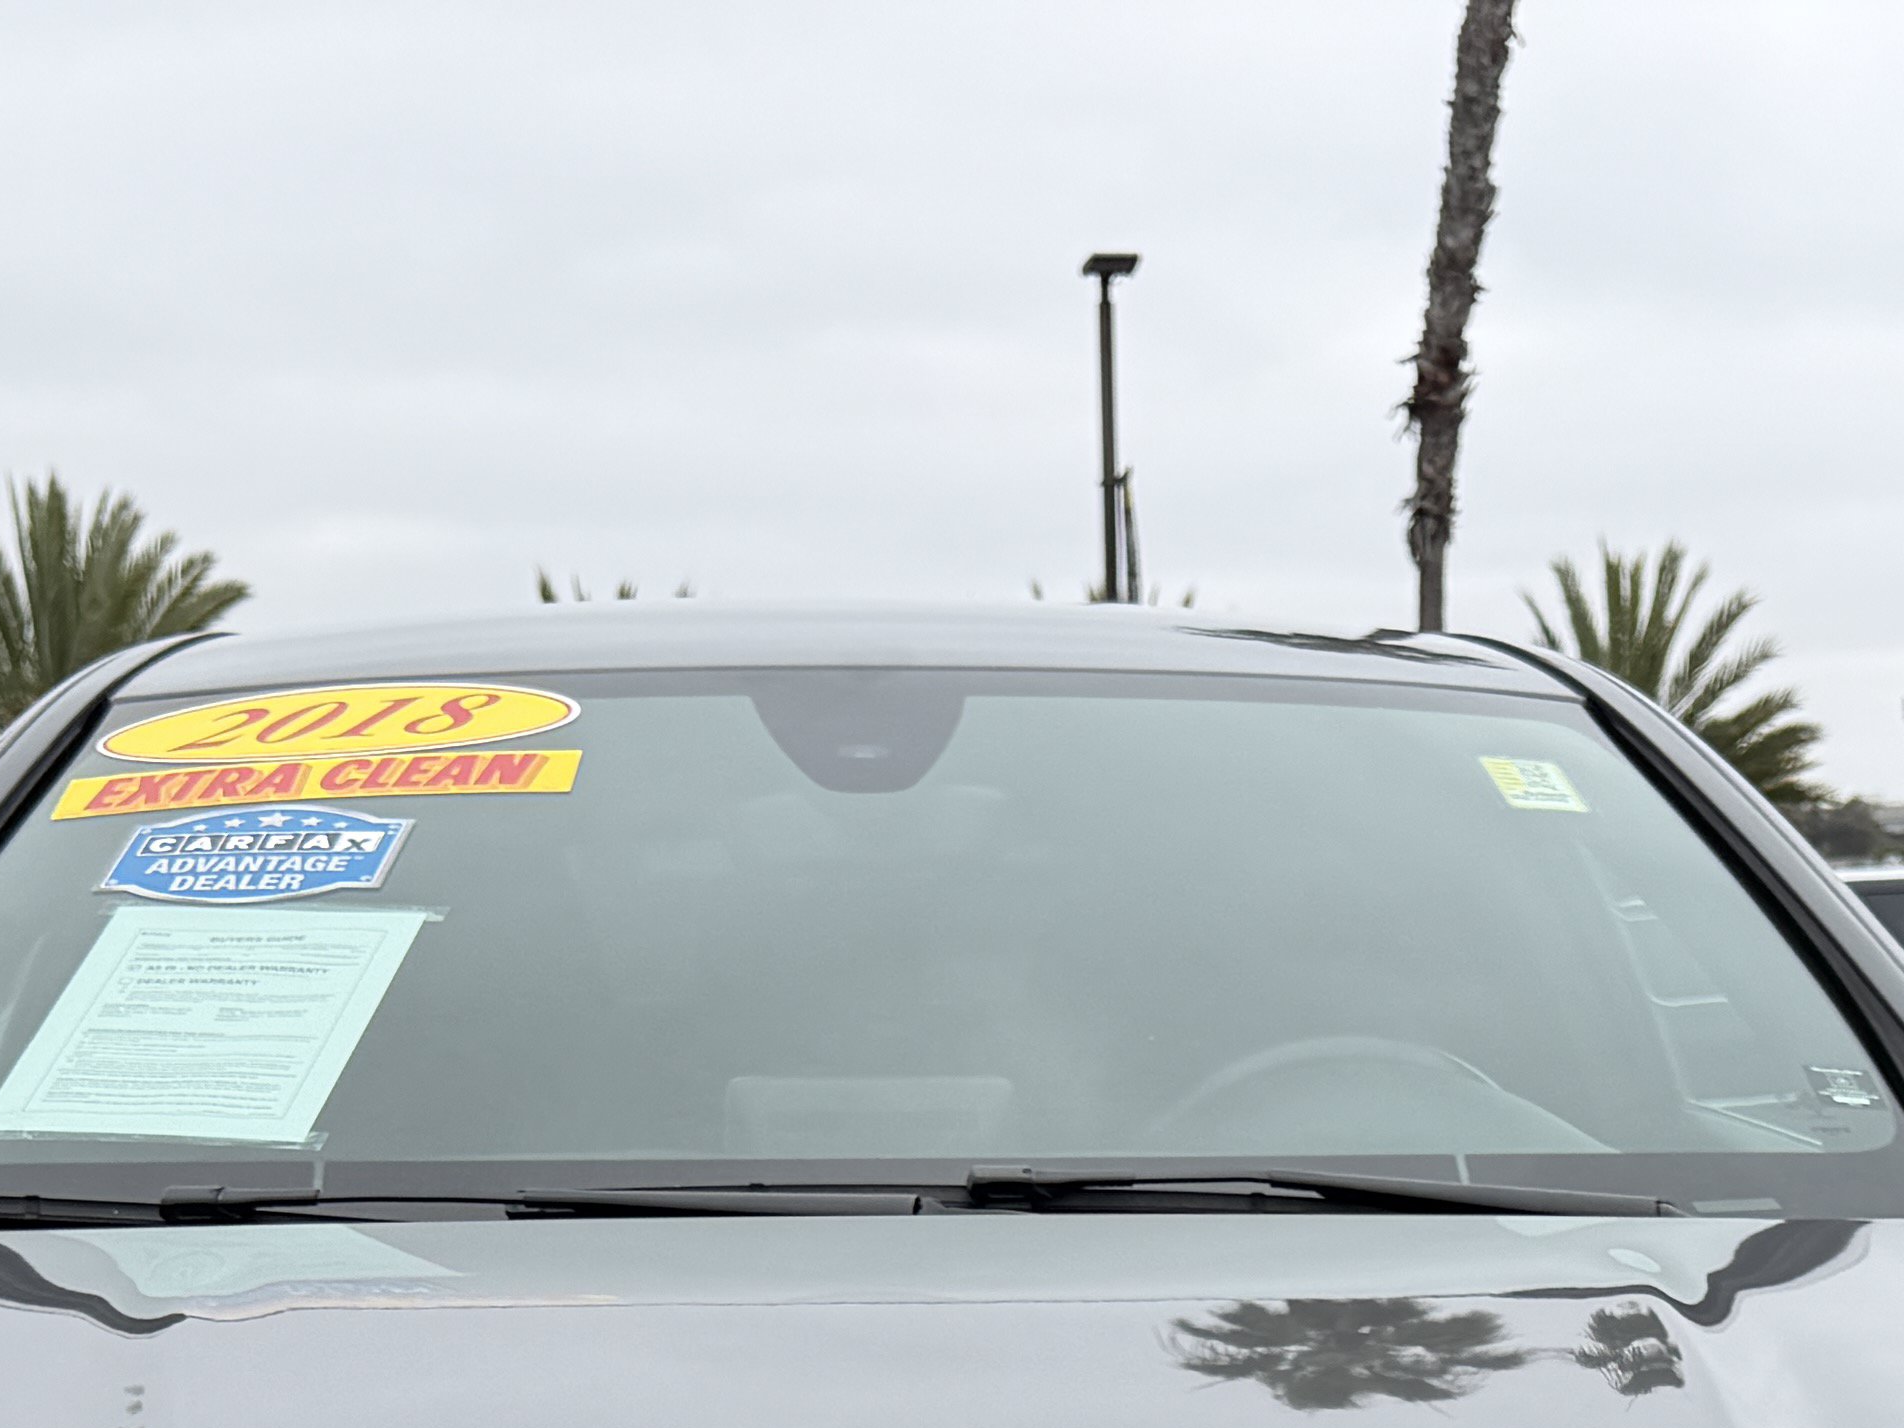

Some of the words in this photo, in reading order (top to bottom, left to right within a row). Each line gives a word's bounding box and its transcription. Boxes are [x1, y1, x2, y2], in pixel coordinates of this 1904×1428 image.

[167, 693, 502, 752] 2018
[83, 763, 306, 811] EXTRA
[320, 753, 542, 793] CLEAN
[143, 832, 383, 854] CARFAX
[144, 855, 349, 874] ADVANTAGE
[169, 873, 304, 891] DEALER
